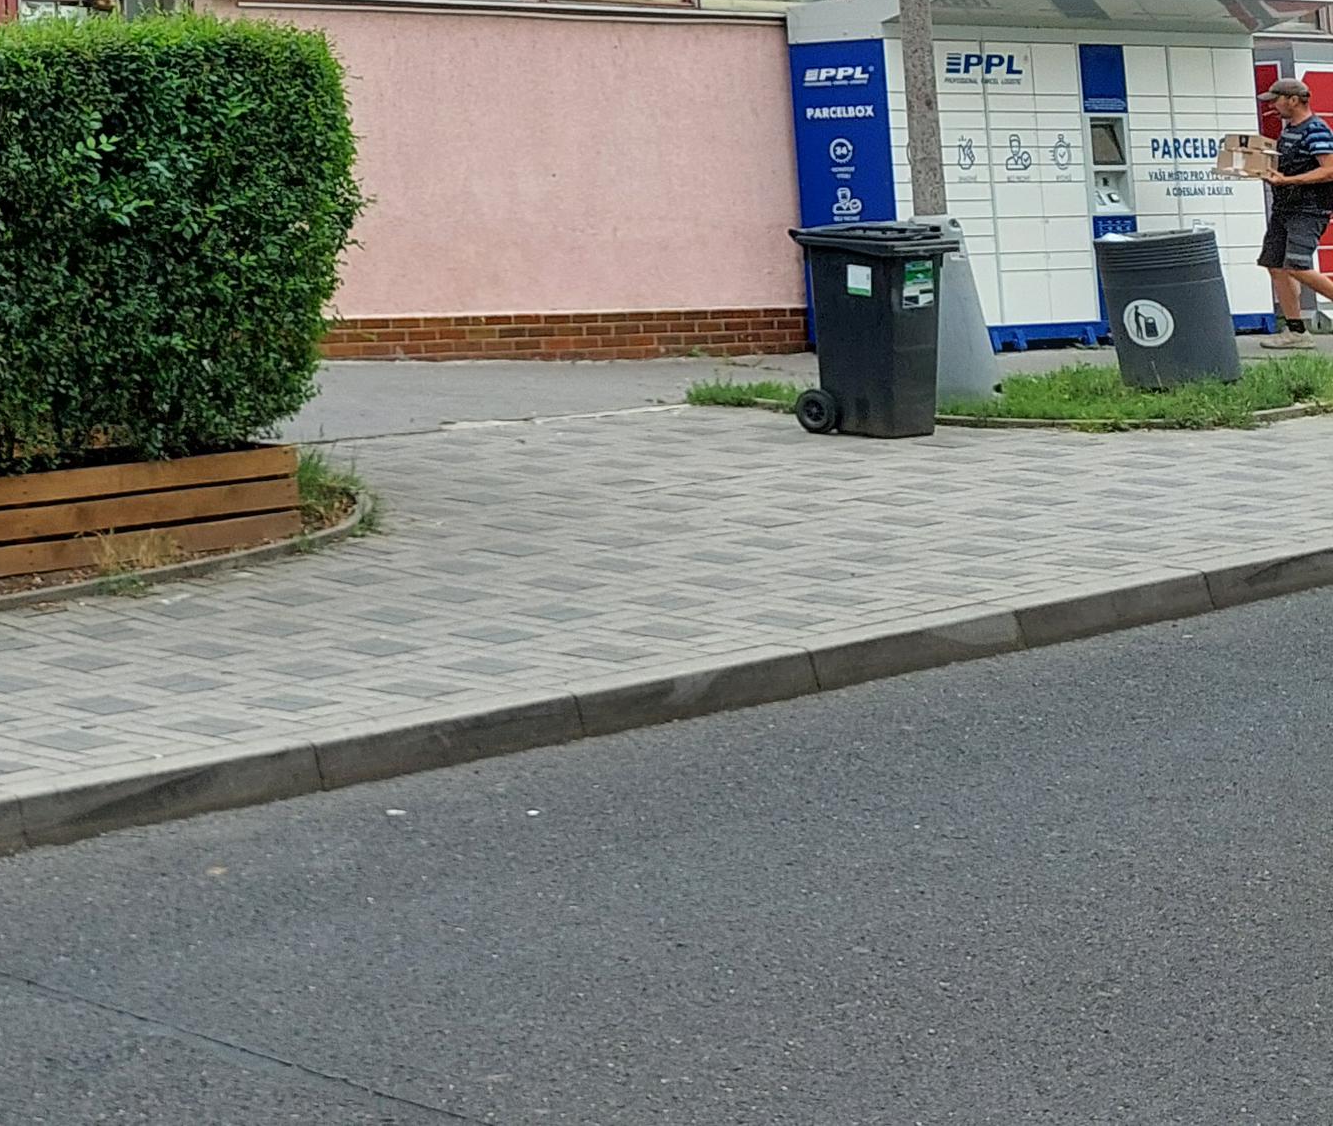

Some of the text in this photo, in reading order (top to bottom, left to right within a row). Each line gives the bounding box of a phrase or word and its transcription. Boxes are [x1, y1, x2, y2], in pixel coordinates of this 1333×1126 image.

[819, 66, 870, 81] PPL
[963, 54, 1023, 75] PPL
[805, 105, 874, 120] PARCELBOX
[1151, 138, 1225, 159] PARCELB
